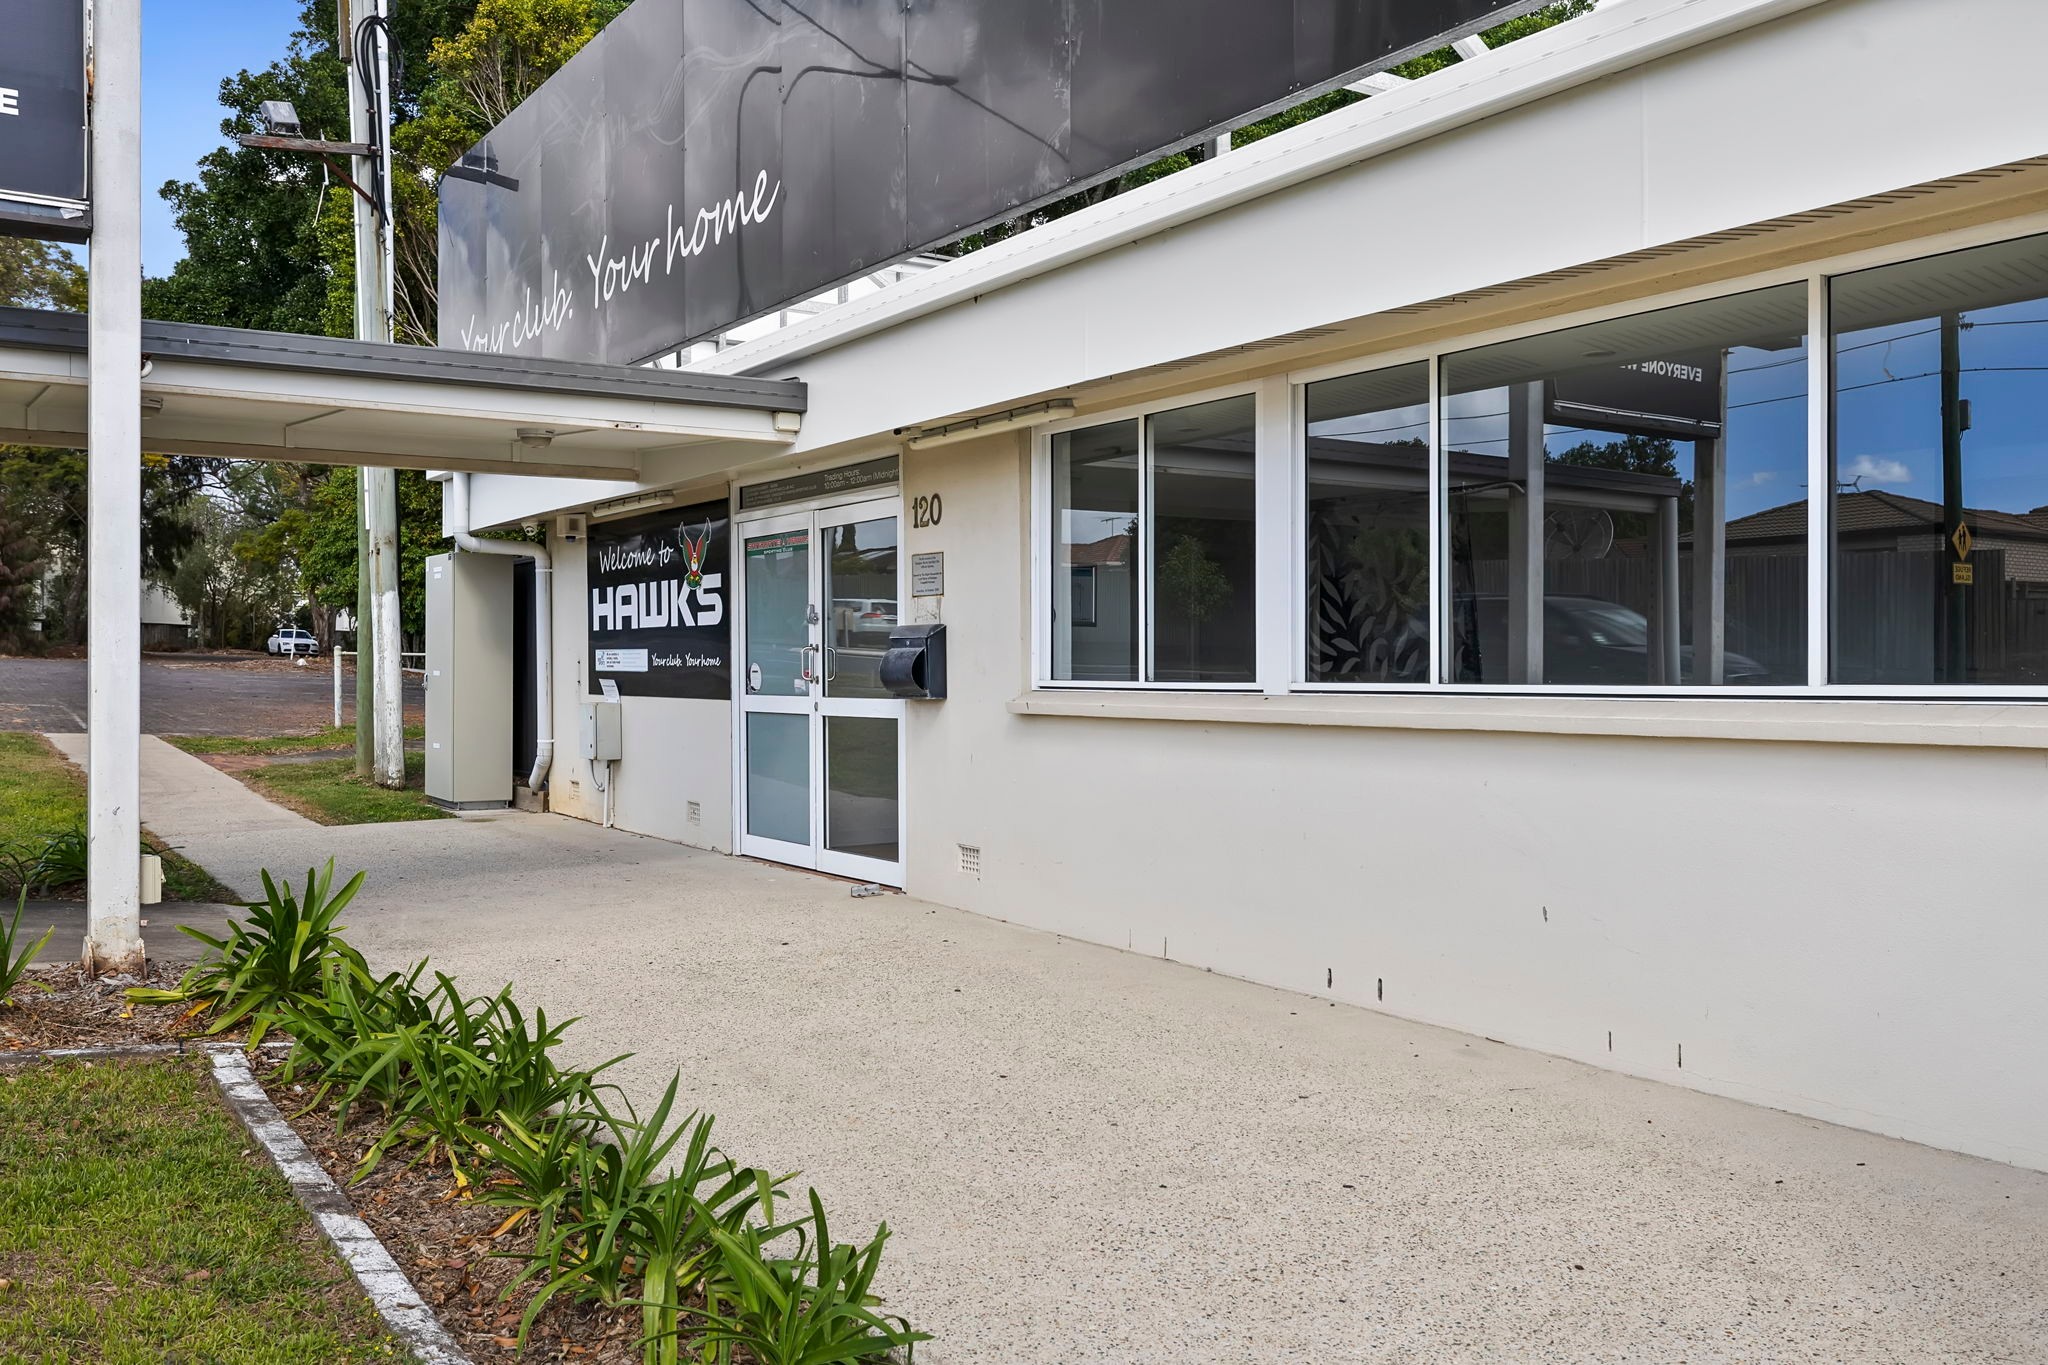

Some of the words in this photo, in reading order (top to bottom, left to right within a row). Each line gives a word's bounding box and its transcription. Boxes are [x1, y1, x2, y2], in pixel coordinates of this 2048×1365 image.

[461, 314, 510, 353] Your
[587, 234, 660, 309] Your
[666, 169, 781, 275] home
[912, 493, 942, 528] 120
[600, 546, 656, 574] Welcome
[659, 540, 674, 567] to
[592, 573, 723, 631] HAWKS
[651, 653, 665, 667] Your
[685, 652, 701, 667] Your
[701, 654, 722, 667] home
